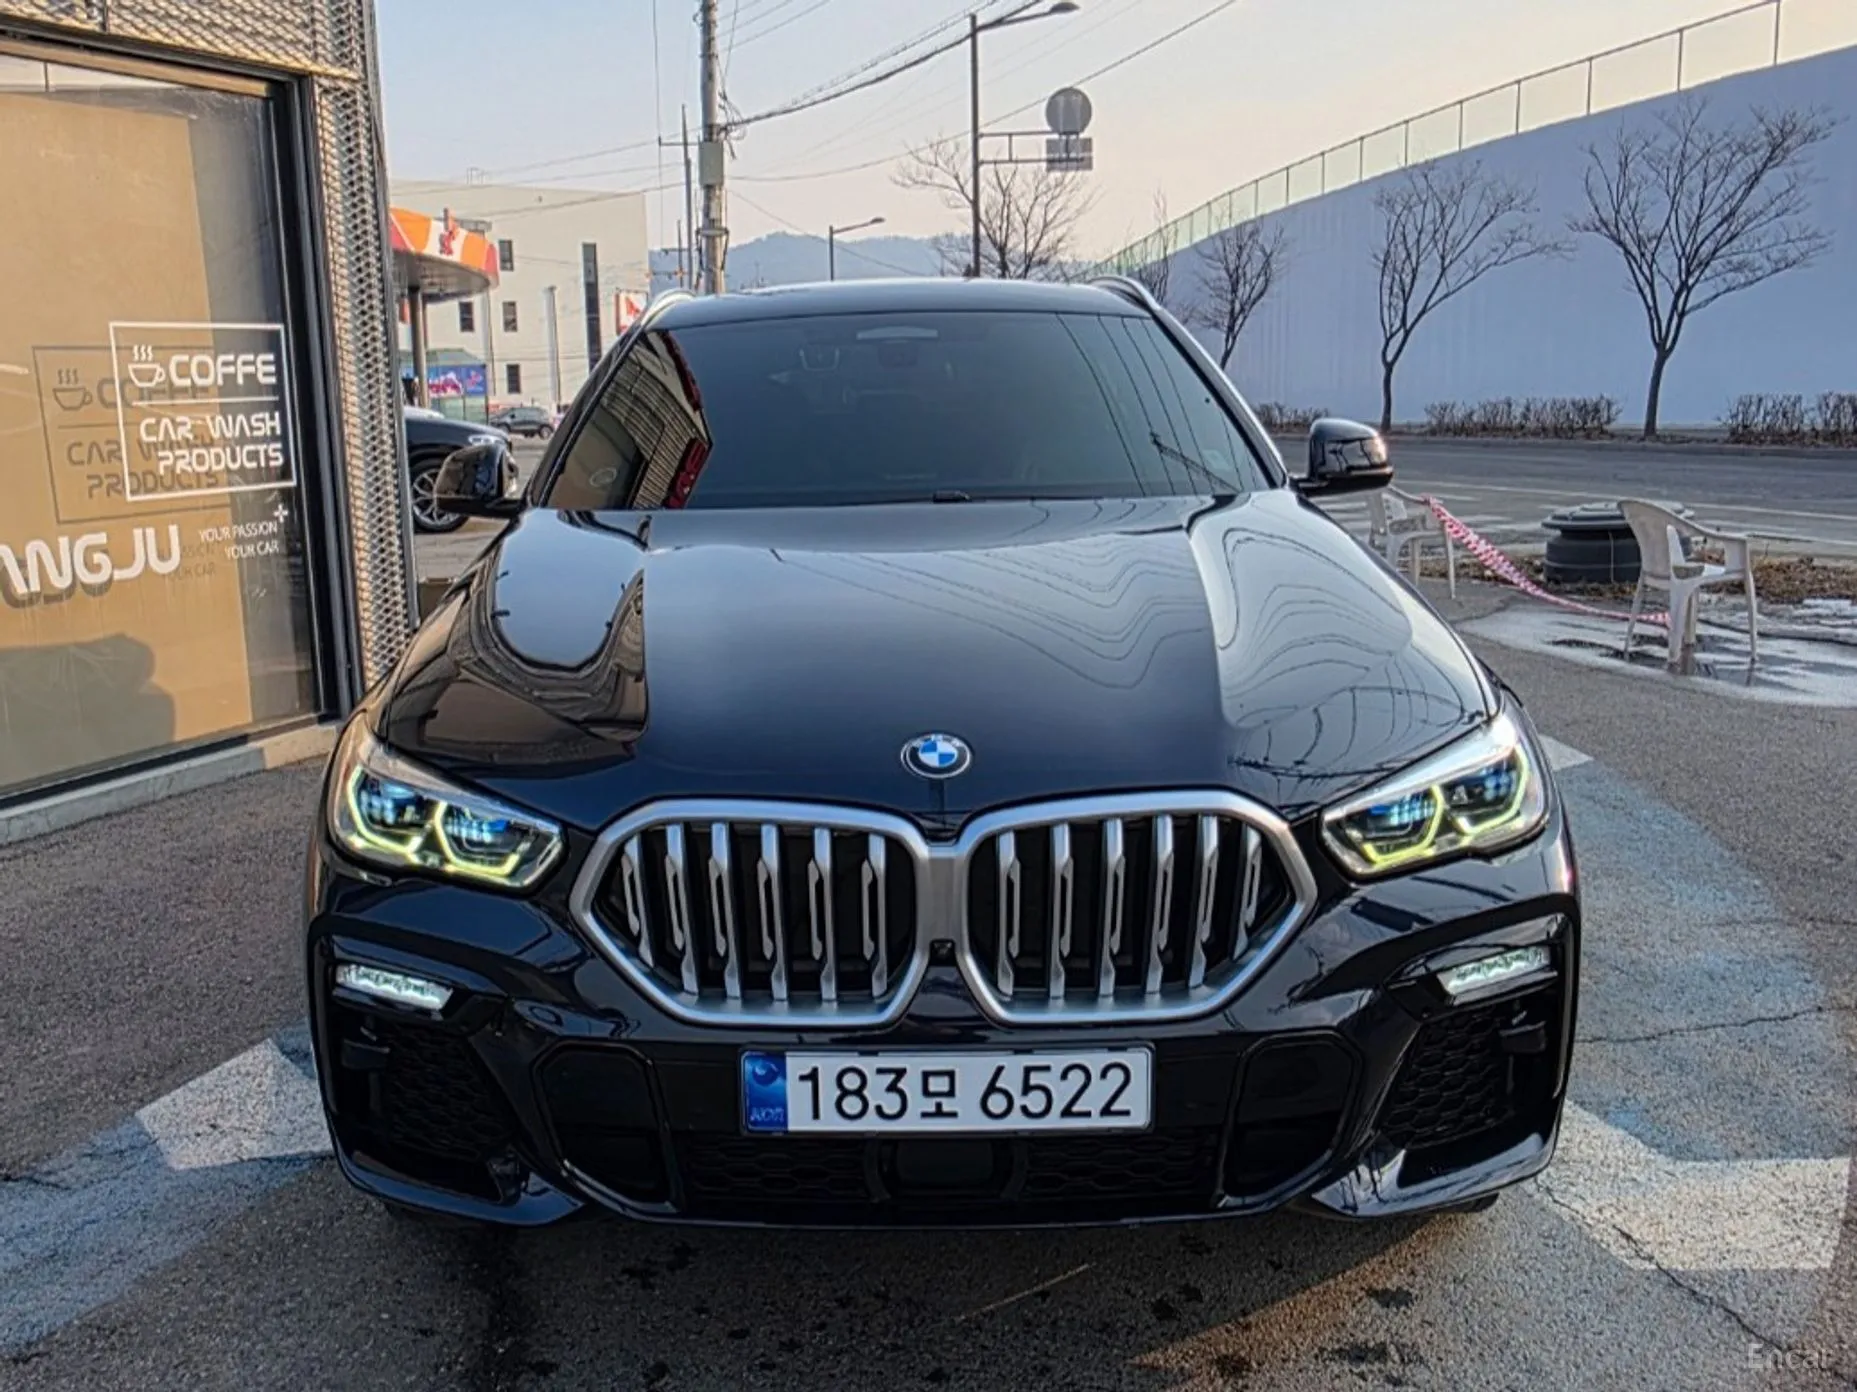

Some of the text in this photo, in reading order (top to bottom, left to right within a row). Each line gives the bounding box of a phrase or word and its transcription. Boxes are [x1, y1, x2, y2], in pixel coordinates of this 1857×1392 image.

[169, 354, 277, 387] COFFE
[139, 411, 281, 443] CAR WASH
[157, 442, 285, 476] PRODUCTS
[198, 519, 278, 543] YOUR PASSION
[224, 539, 280, 561] YOUR CAR
[798, 1062, 1132, 1121] 183모 6522
